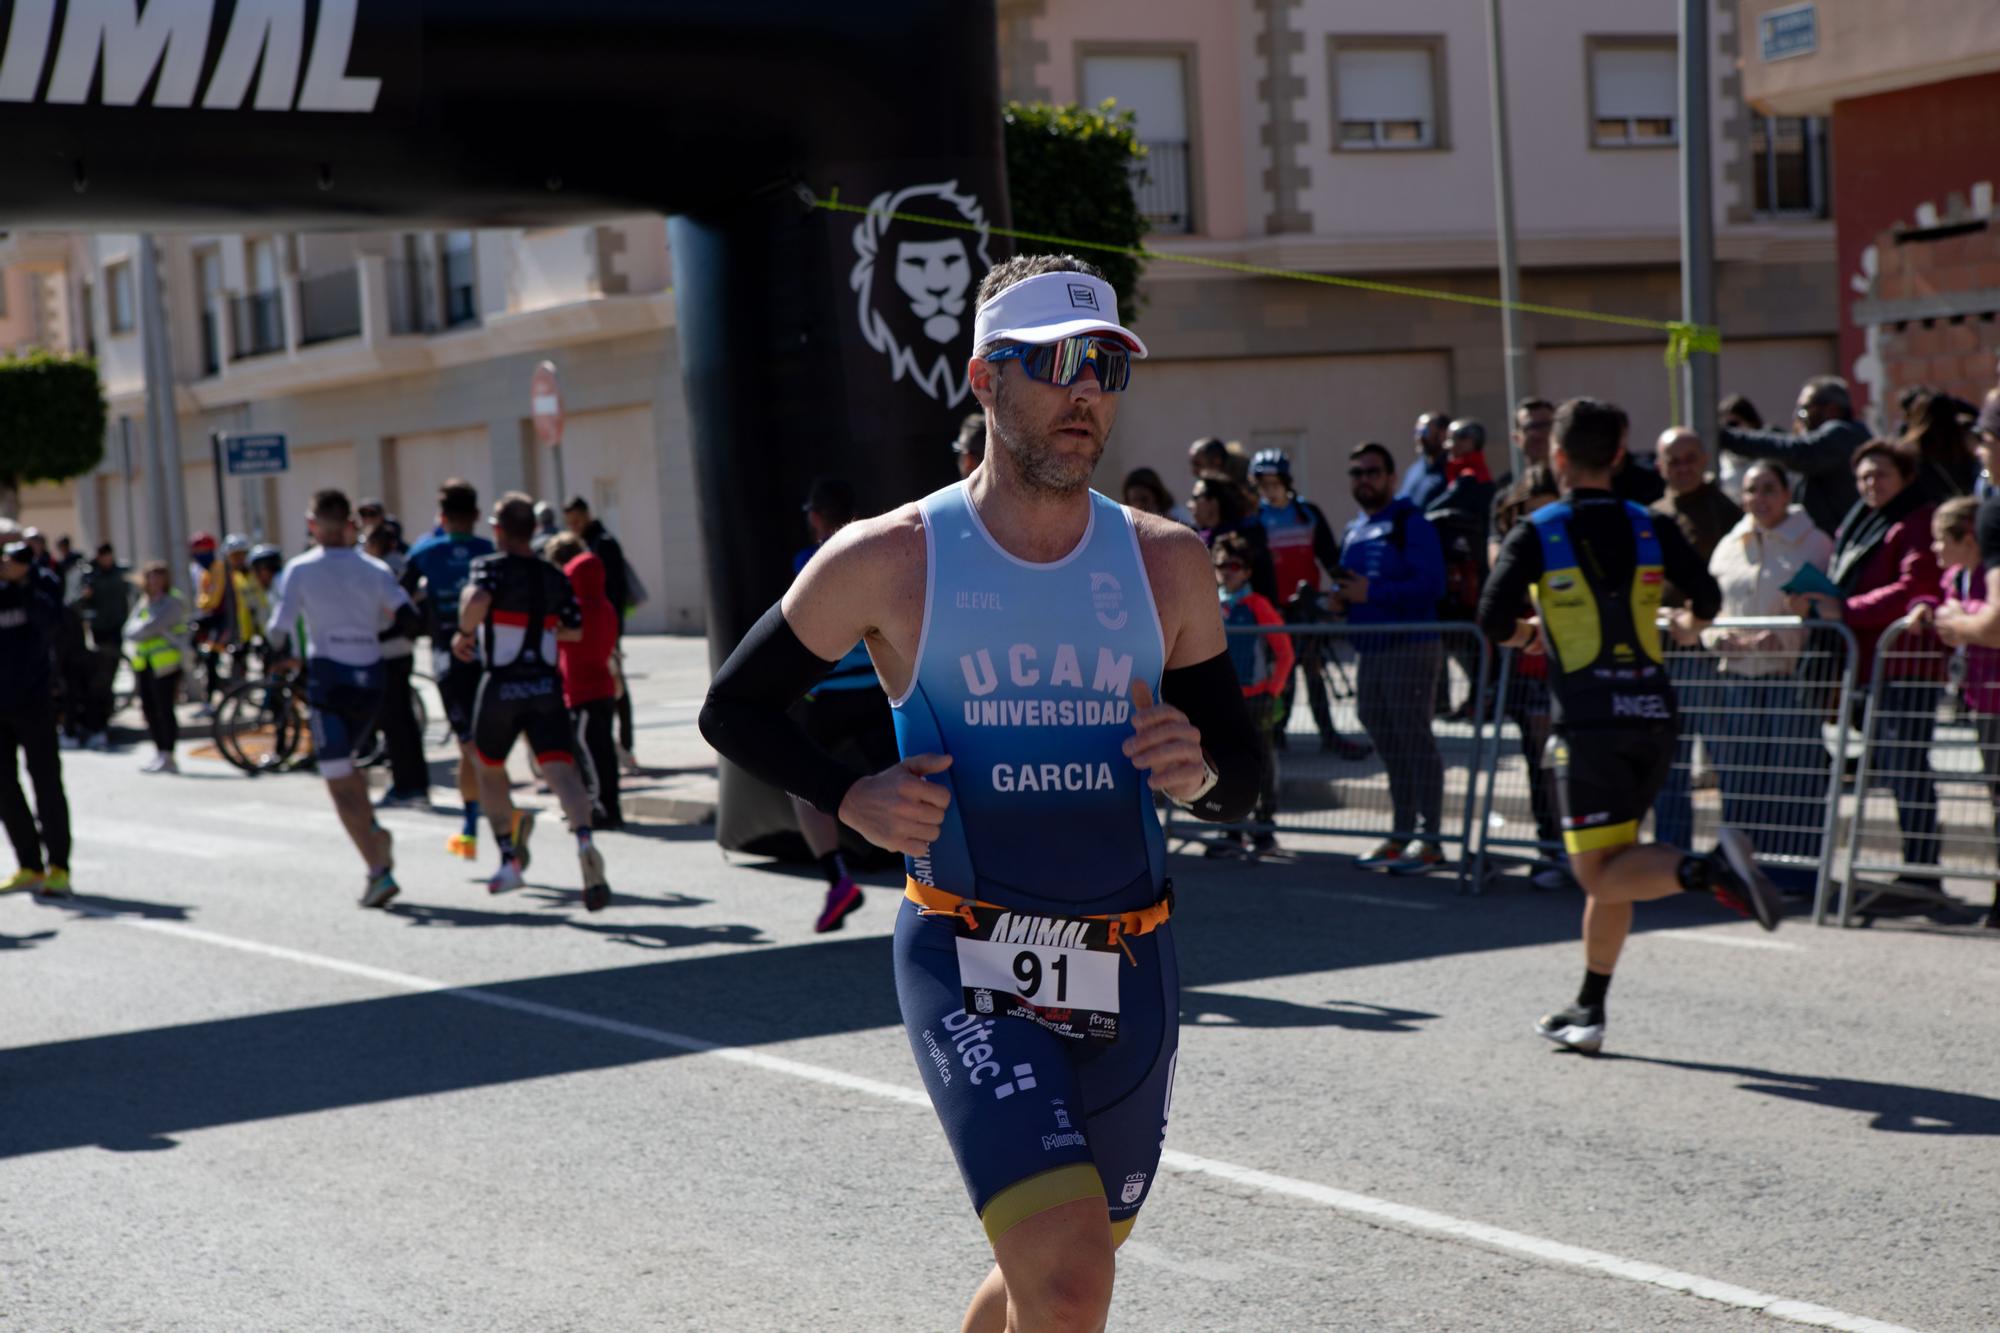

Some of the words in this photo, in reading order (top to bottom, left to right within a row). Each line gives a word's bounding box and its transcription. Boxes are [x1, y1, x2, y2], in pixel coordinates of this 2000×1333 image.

[960, 644, 1133, 698] UCAM
[964, 700, 1129, 727] UNIVERSIDAD
[992, 762, 1114, 792] GARCIA
[990, 912, 1090, 950] ANIMAL
[1013, 951, 1068, 1002] 91
